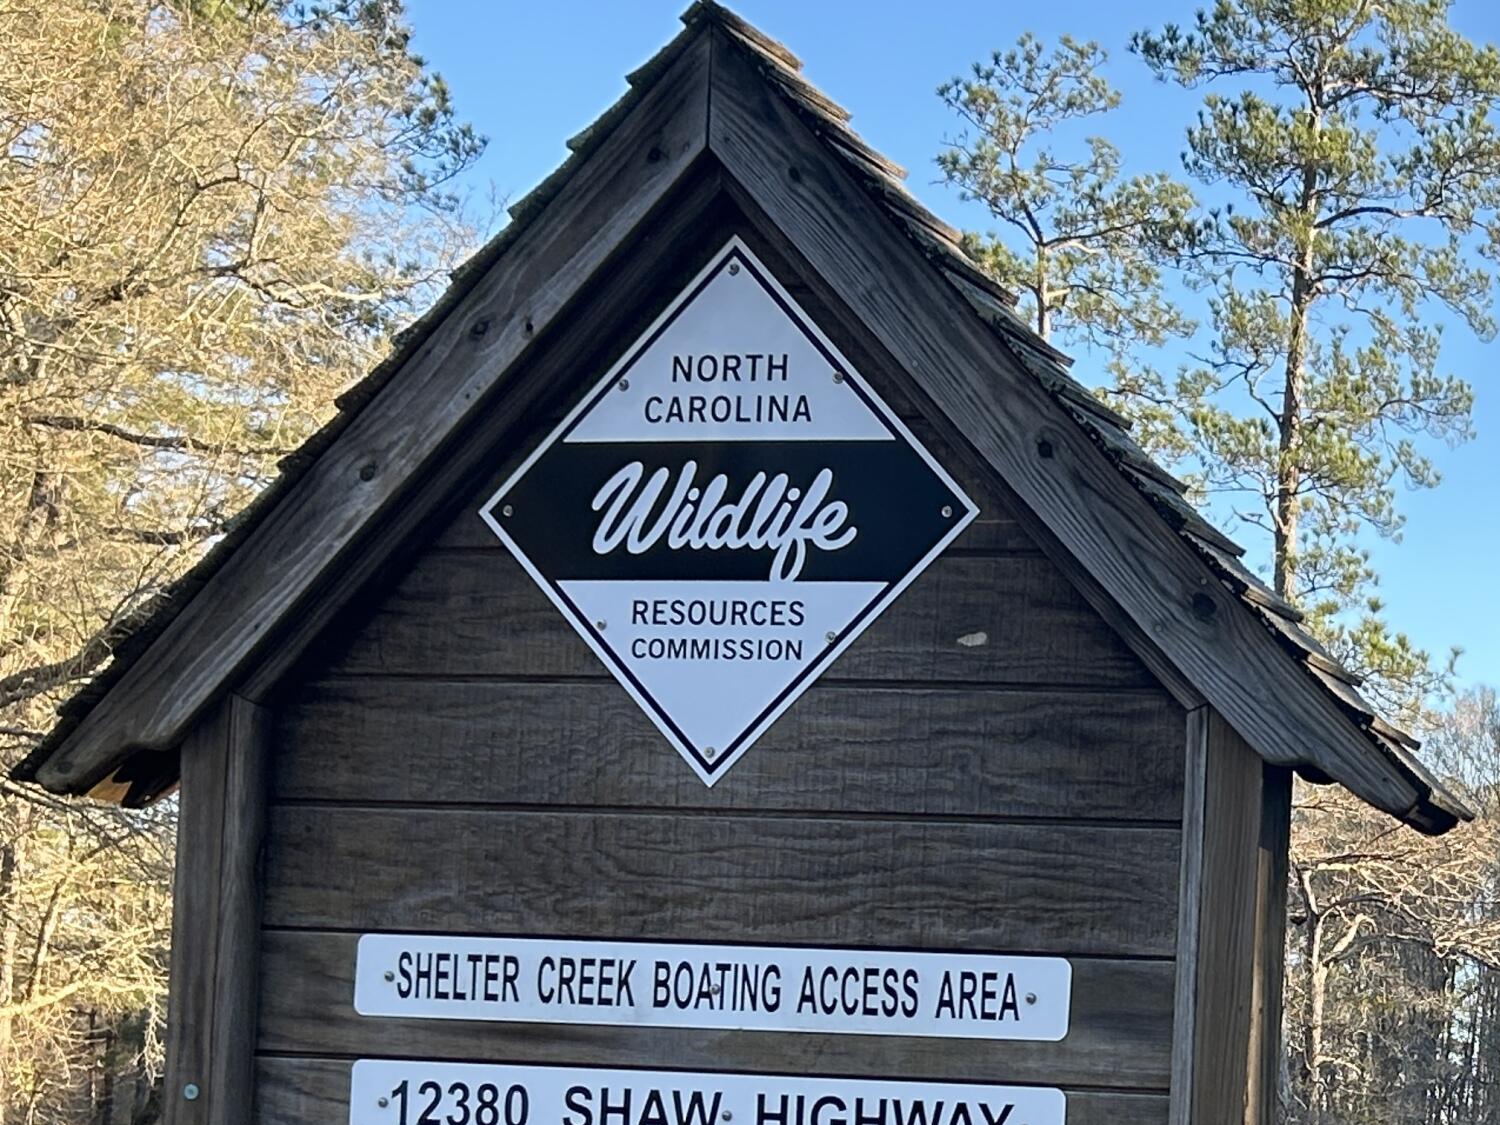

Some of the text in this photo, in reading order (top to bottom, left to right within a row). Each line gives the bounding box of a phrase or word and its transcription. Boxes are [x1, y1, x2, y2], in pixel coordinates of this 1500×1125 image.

[671, 354, 789, 382] NORTH
[644, 395, 812, 423] CAROLINA
[591, 460, 857, 581] Wildlife
[632, 600, 805, 626] RESOURCES
[631, 638, 803, 661] COMMISSION
[396, 951, 1020, 1021] SHELTER CREEK BOATING ACCESS AREA
